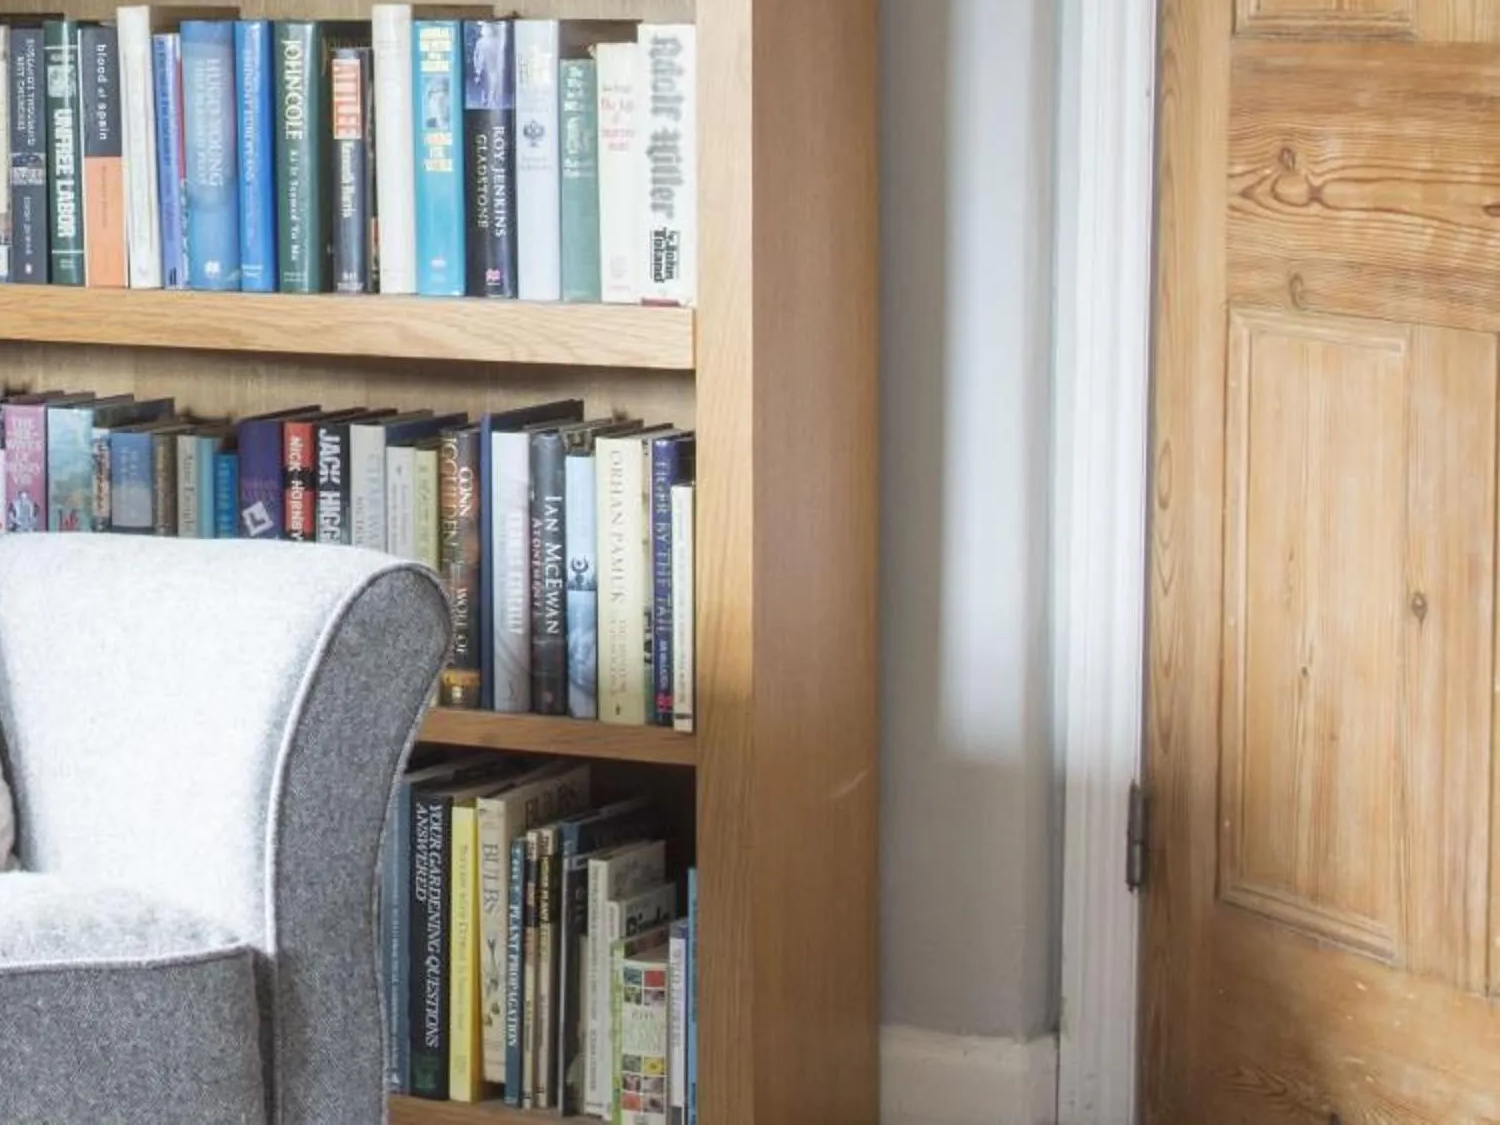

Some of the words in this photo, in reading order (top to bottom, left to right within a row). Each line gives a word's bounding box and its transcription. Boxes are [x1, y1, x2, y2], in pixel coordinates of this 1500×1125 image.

[96, 44, 108, 83] blood
[206, 58, 221, 115] HUGO
[282, 39, 302, 93] JOHN
[648, 33, 685, 123] Adolf
[96, 102, 109, 141] spain
[284, 93, 303, 140] COLE
[336, 62, 360, 138] ATTLEE
[54, 108, 73, 177] UNFREE
[208, 118, 223, 187] YOUNG
[491, 125, 506, 159] ROY
[645, 124, 685, 221] Hitler
[55, 178, 76, 238] LABOR
[476, 134, 489, 228] GLADSTONE
[491, 164, 507, 238] JENKINS
[652, 226, 667, 284] Toland
[288, 436, 302, 474] NICK
[318, 428, 341, 486] JACK
[290, 480, 305, 541] HORNBY
[440, 436, 458, 546] IGGULDEN
[458, 466, 473, 517] CONN
[545, 495, 563, 531] IAN
[607, 450, 623, 526] ORHAN
[609, 531, 625, 603] PAMUK
[454, 587, 468, 624] WOLF
[415, 802, 429, 901] ANSWERED
[428, 803, 442, 850] YOUR
[426, 851, 441, 953] GARDENING
[482, 842, 500, 915] BULBS
[508, 904, 521, 951] PLANT
[424, 955, 440, 1048] QUESTIONS
[507, 954, 520, 1047] PROPAGATION
